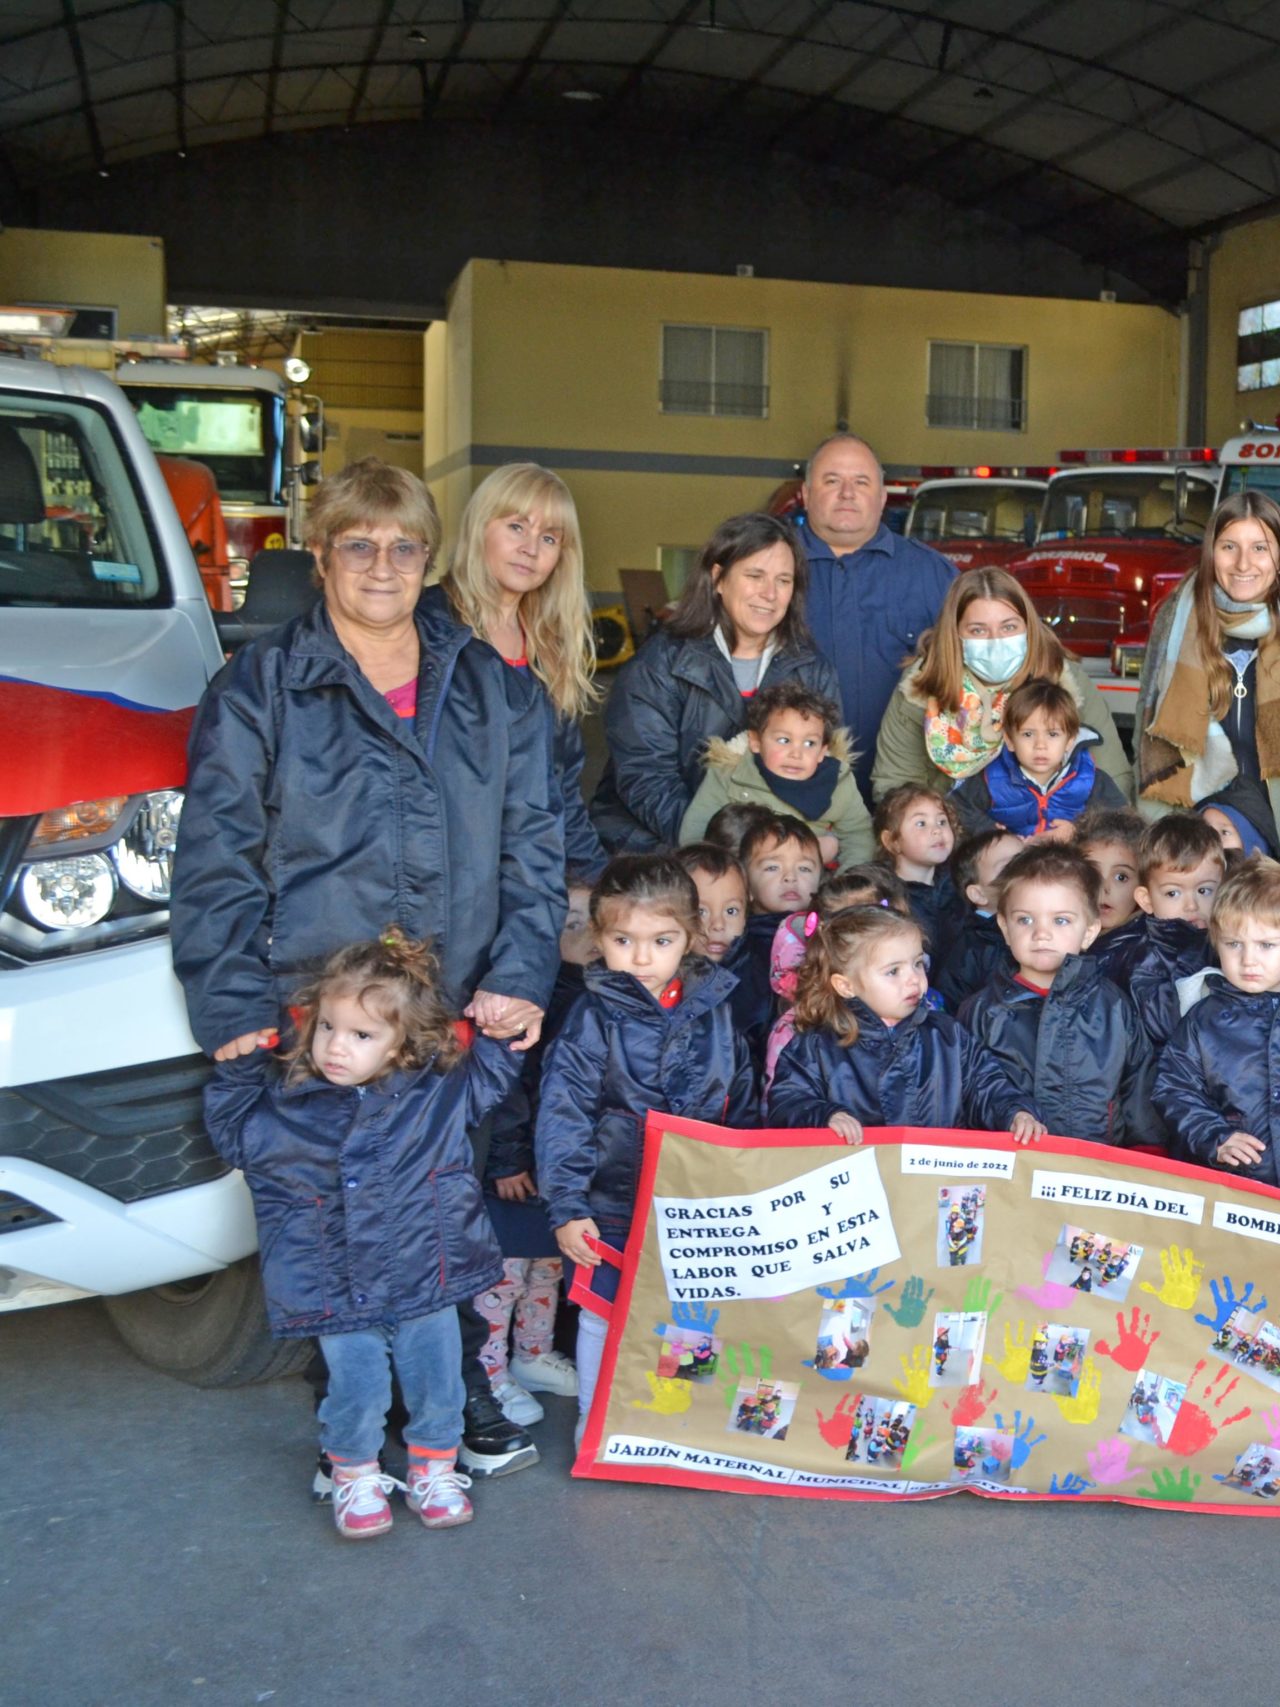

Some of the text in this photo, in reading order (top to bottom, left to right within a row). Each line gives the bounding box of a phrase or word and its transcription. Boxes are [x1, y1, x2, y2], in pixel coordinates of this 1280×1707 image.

[909, 1157, 1008, 1171] 2 de junio de 2022
[664, 1170, 851, 1221] GRACIAS POR SU
[1061, 1185, 1112, 1203] FELIZ
[1117, 1191, 1149, 1209] DÍA
[1153, 1200, 1189, 1217] DEL
[667, 1202, 834, 1241] ENTREGA Y
[669, 1208, 880, 1260] COMPROMISO EN ESTA
[672, 1235, 872, 1281] LABOR QUE SALVA
[674, 1286, 742, 1301] VIDAS.
[608, 1442, 681, 1459] JARDÍN
[683, 1453, 788, 1480] MATERNAL
[797, 1473, 903, 1490] MUNICIPAL
